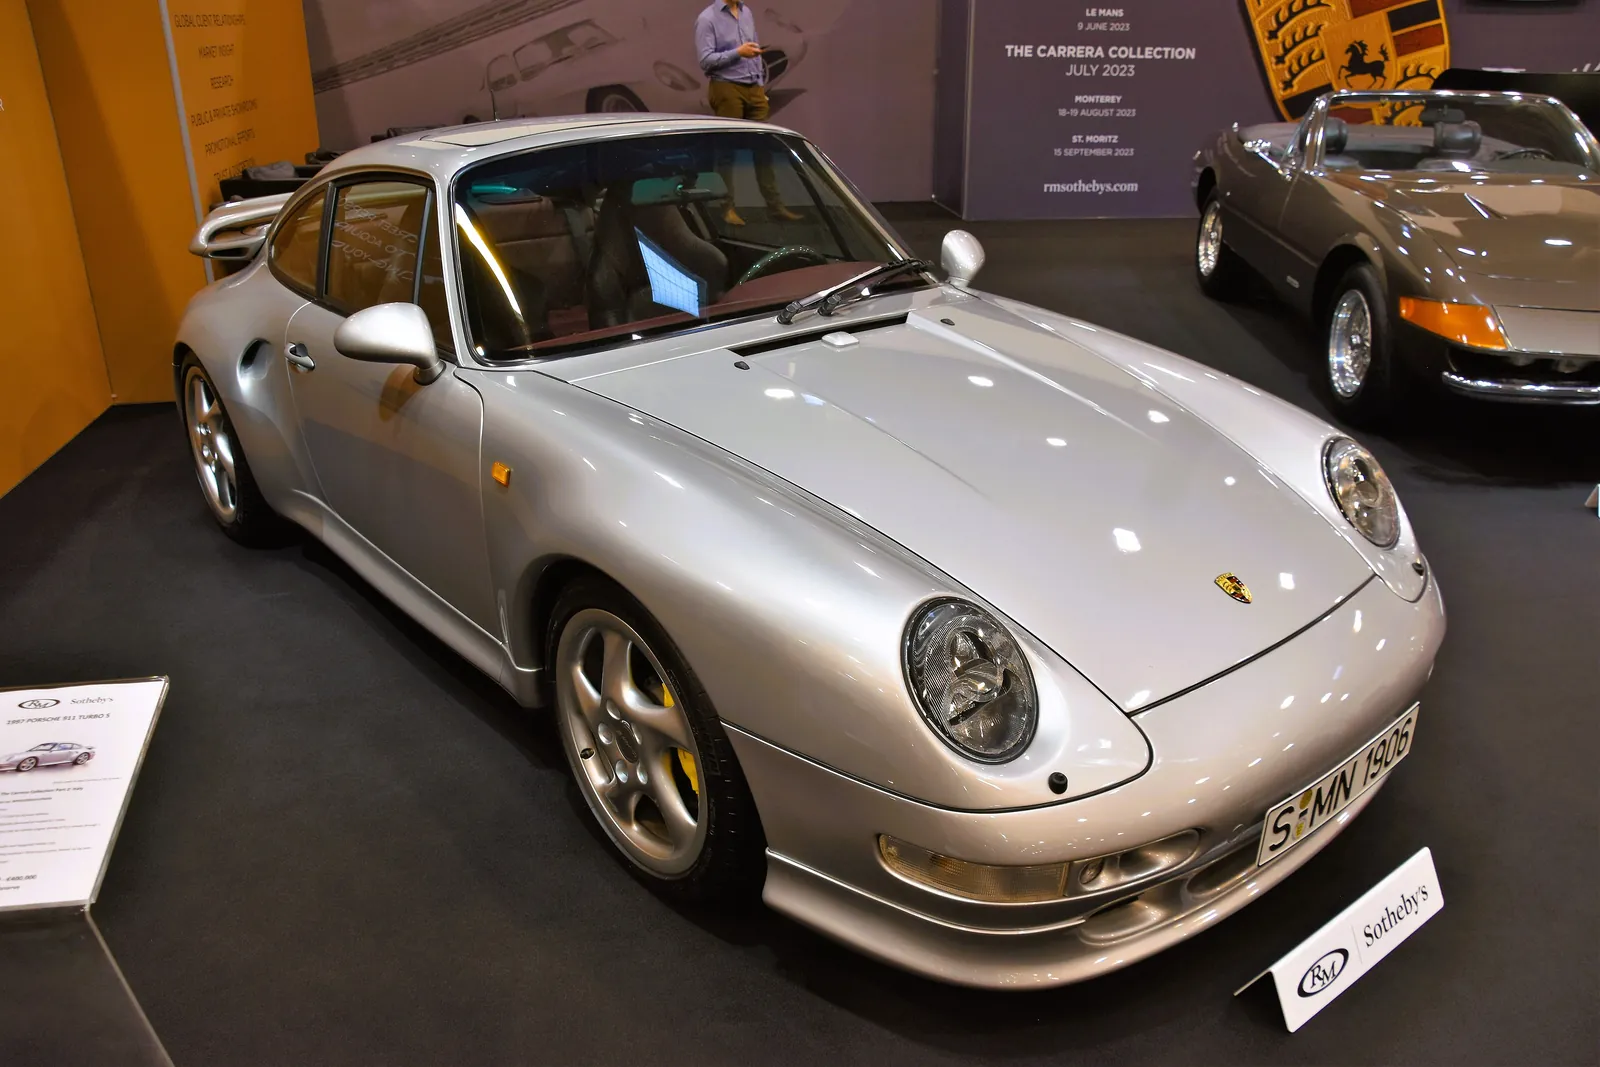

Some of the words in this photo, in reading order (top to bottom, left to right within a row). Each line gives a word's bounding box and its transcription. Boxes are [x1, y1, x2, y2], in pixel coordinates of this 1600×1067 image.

[1086, 8, 1097, 16] LE
[1098, 8, 1124, 17] MANS
[1077, 22, 1084, 30] 9
[1085, 22, 1108, 31] JUNE
[1109, 22, 1130, 32] 2023
[1006, 45, 1033, 58] THE
[1036, 45, 1104, 58] CARRERA
[1108, 46, 1196, 60] COLLECTION
[1065, 64, 1098, 77] JULY
[1102, 64, 1136, 77] 2023
[1074, 95, 1122, 103] MONTEREY
[1058, 108, 1078, 116] 18-19
[1080, 108, 1114, 116] AUGUST
[1116, 108, 1136, 117] 2023
[1072, 135, 1084, 143] ST.
[1086, 135, 1118, 143] MORITZ
[1054, 148, 1062, 156] 15
[1064, 148, 1112, 156] SEPTEMBER
[1114, 148, 1134, 156] 2023
[1044, 179, 1138, 195] rmsothebys.com
[70, 696, 114, 705] Sotheby's
[1363, 717, 1412, 786] 1906
[1362, 884, 1428, 948] Sotheby's
